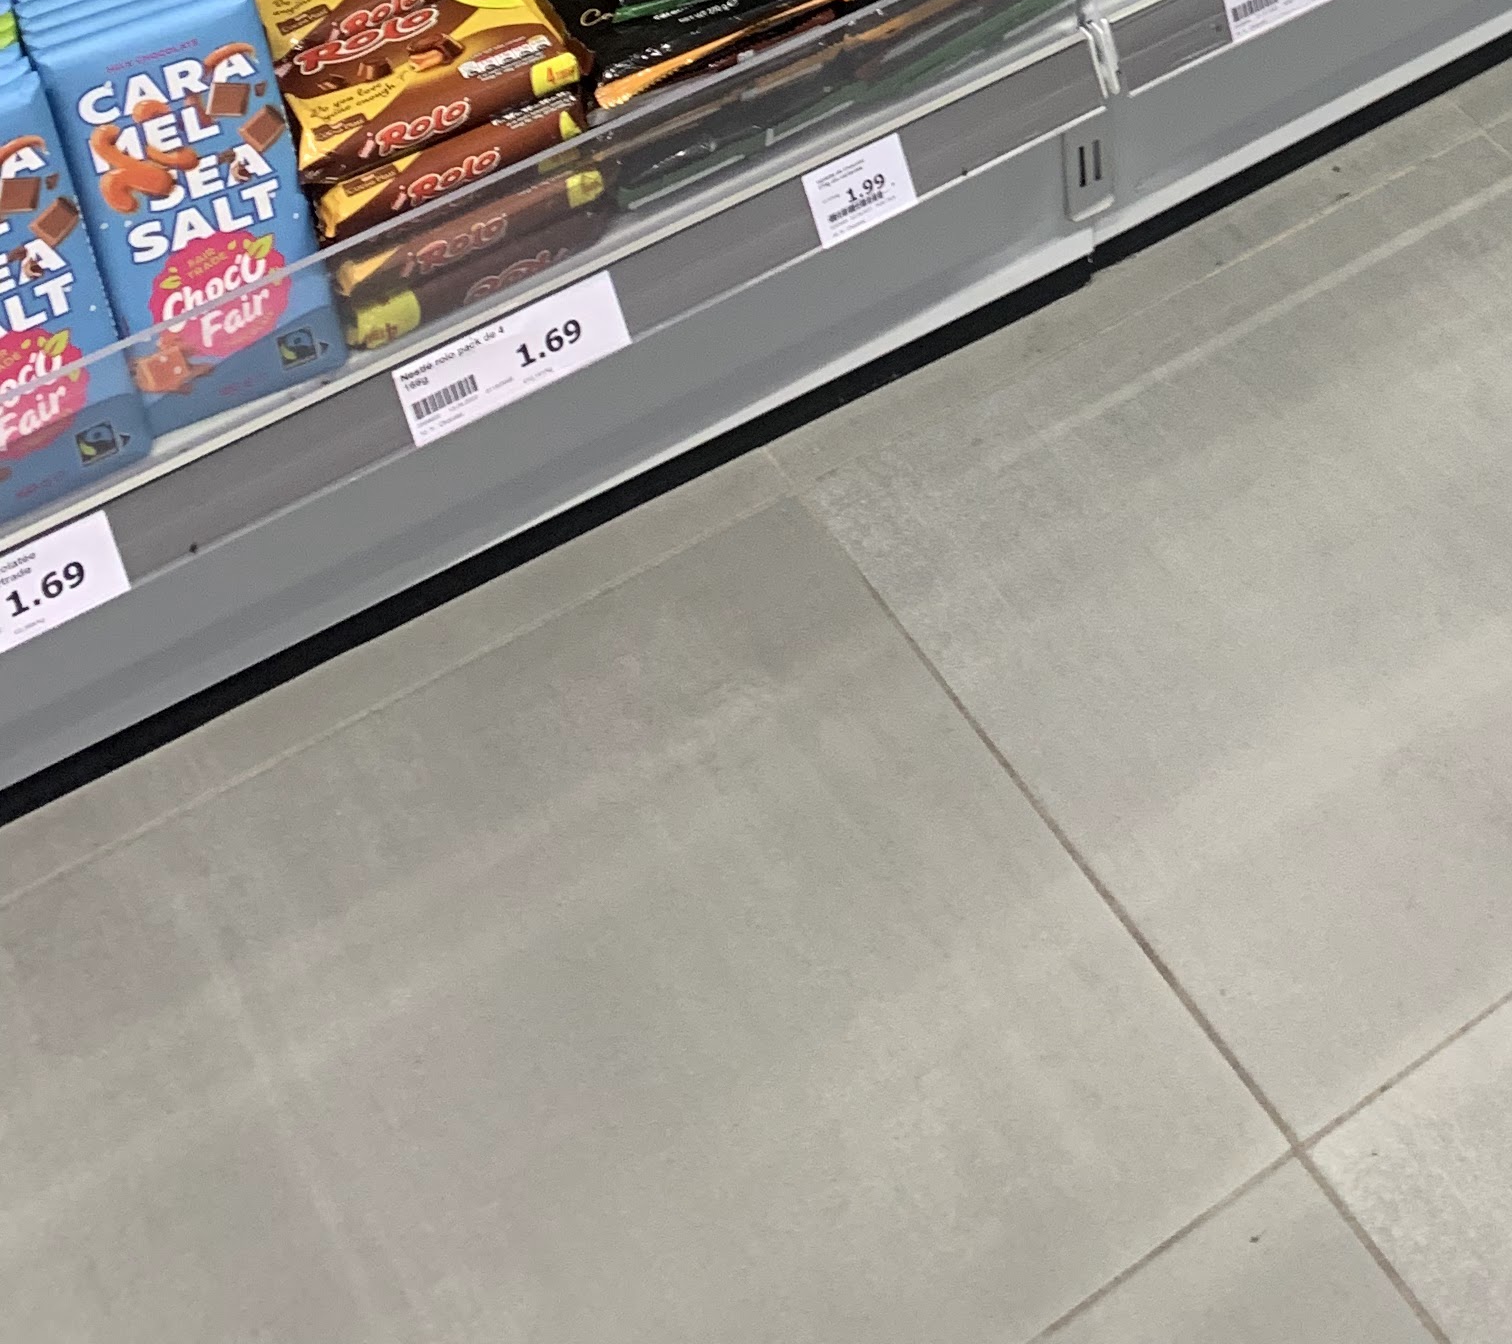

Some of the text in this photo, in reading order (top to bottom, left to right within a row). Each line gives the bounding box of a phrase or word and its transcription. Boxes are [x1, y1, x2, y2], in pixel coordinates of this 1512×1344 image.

[78, 48, 258, 127] CARA
[847, 174, 885, 202] 1.99
[128, 180, 280, 264] SALT
[200, 286, 272, 350] Fair
[515, 319, 582, 367] 1.69
[457, 338, 482, 360] pack
[5, 561, 86, 618] 1.69
